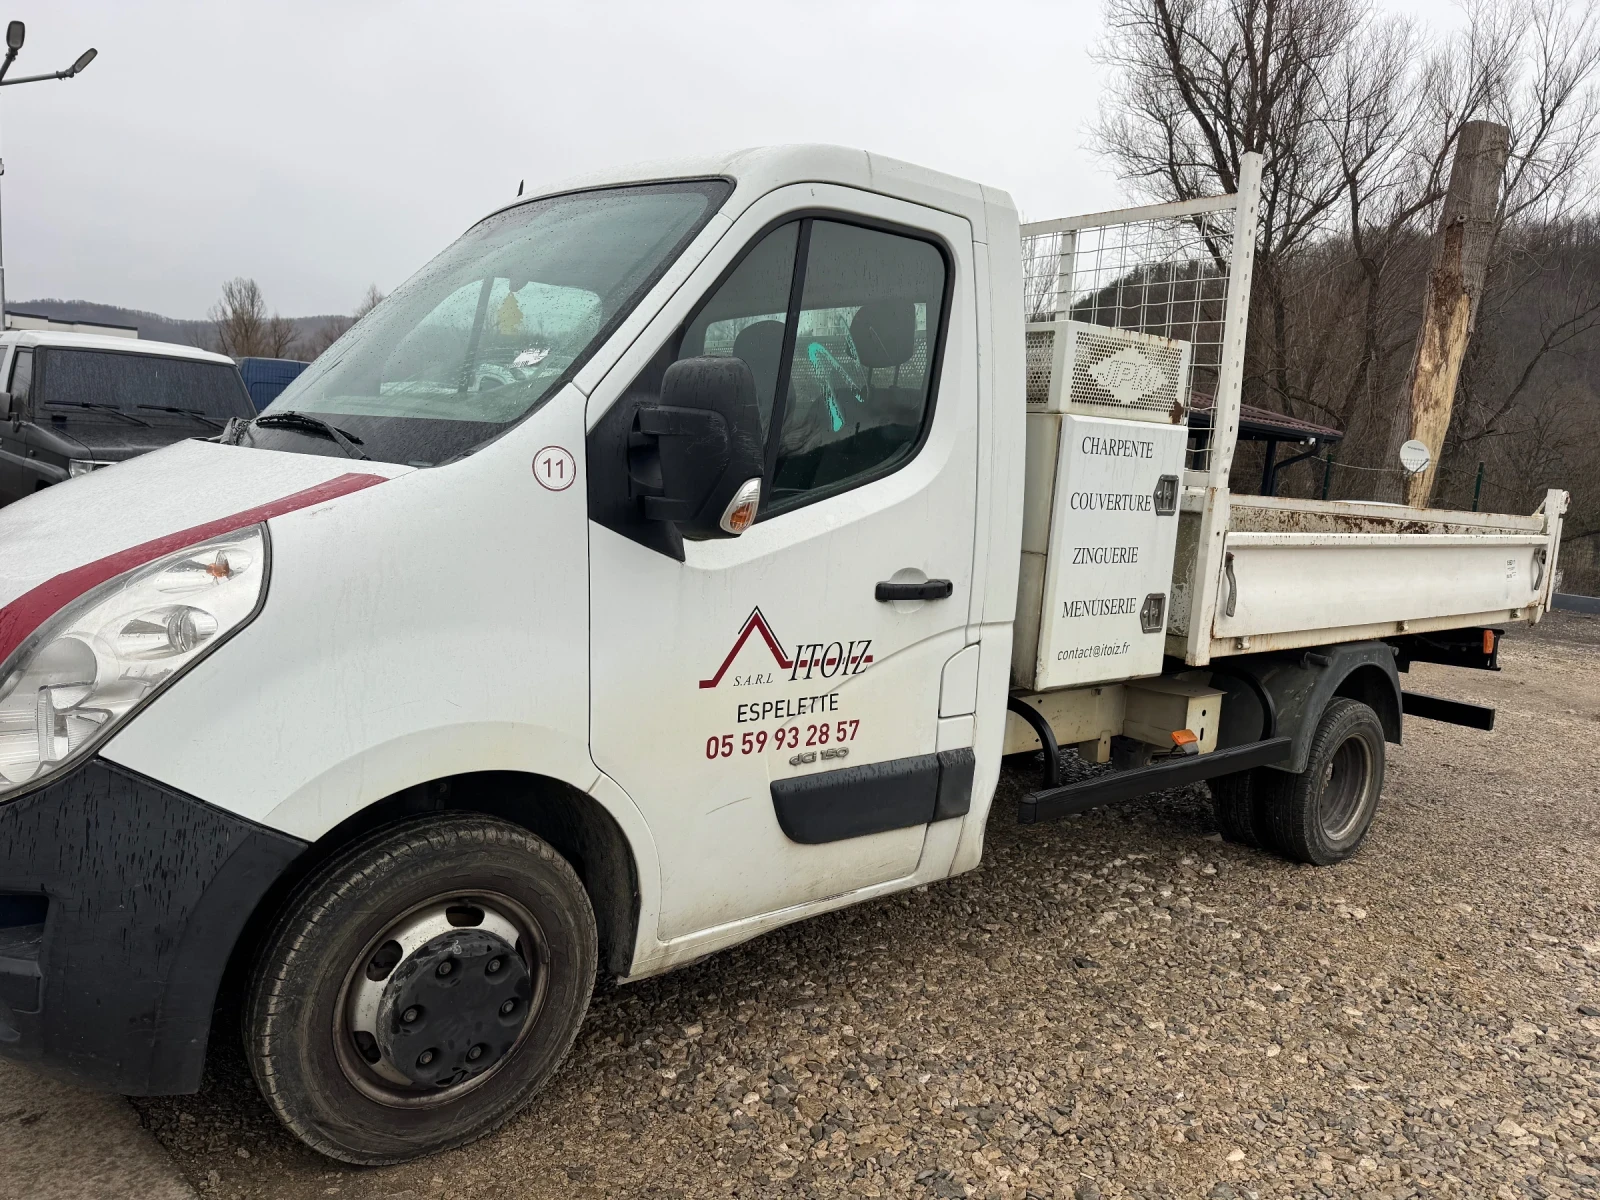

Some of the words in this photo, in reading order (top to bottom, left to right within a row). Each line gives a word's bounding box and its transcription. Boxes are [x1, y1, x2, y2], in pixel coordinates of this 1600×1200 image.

[1096, 360, 1160, 393] JPM
[1081, 436, 1154, 459] CHARPENTE
[543, 457, 564, 479] 11
[1070, 491, 1152, 512] COUVERTURE
[1072, 546, 1139, 565] ZINGUERIE
[1062, 597, 1137, 618] MENUISERIE
[787, 639, 873, 682] ITOIZ
[1057, 641, 1131, 661] contact@itoiz.fr
[737, 693, 839, 723] ESPELETTE
[706, 734, 734, 760] 05
[741, 730, 768, 755] 59
[774, 726, 800, 749] 93
[805, 722, 830, 747] 28
[836, 719, 860, 742] 57
[820, 746, 849, 761] 150
